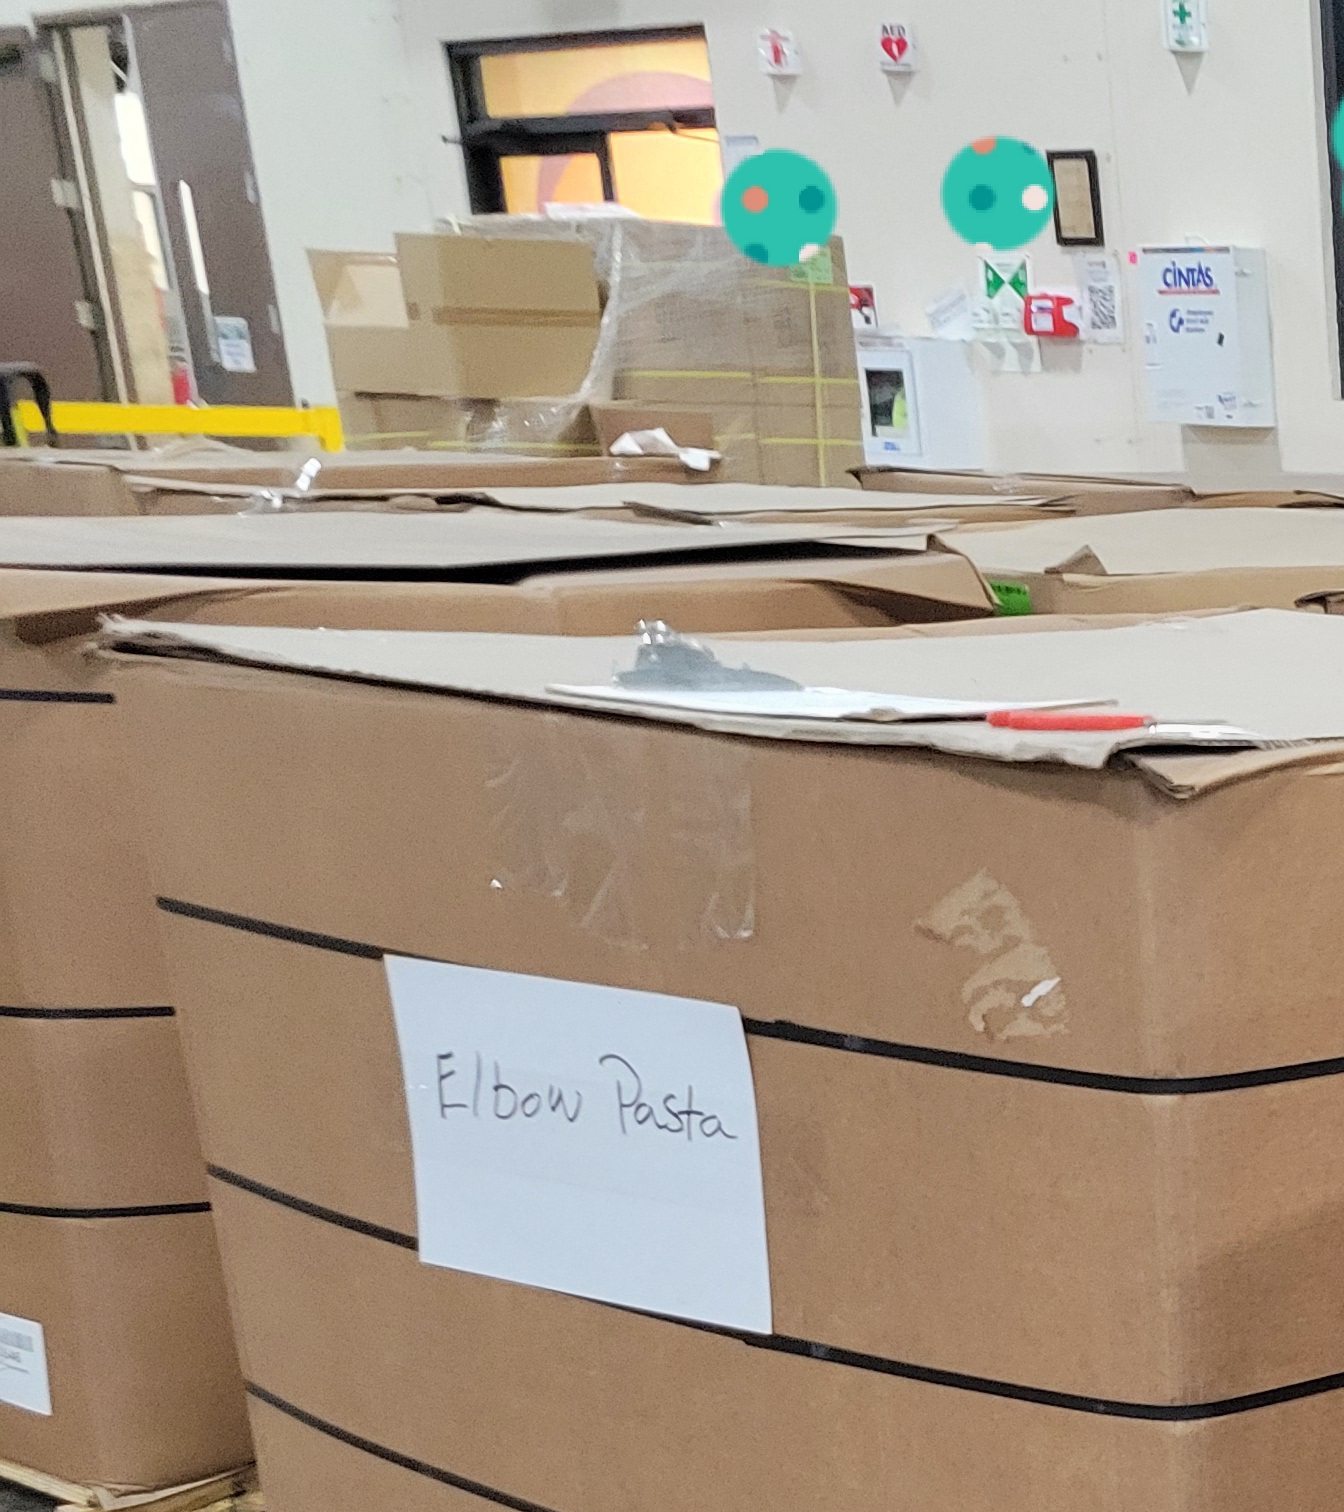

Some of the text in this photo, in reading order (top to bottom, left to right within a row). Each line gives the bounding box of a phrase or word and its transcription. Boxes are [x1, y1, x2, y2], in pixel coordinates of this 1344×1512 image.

[1162, 260, 1214, 288] CINTAS
[437, 1050, 738, 1142] Elbow Pasta
